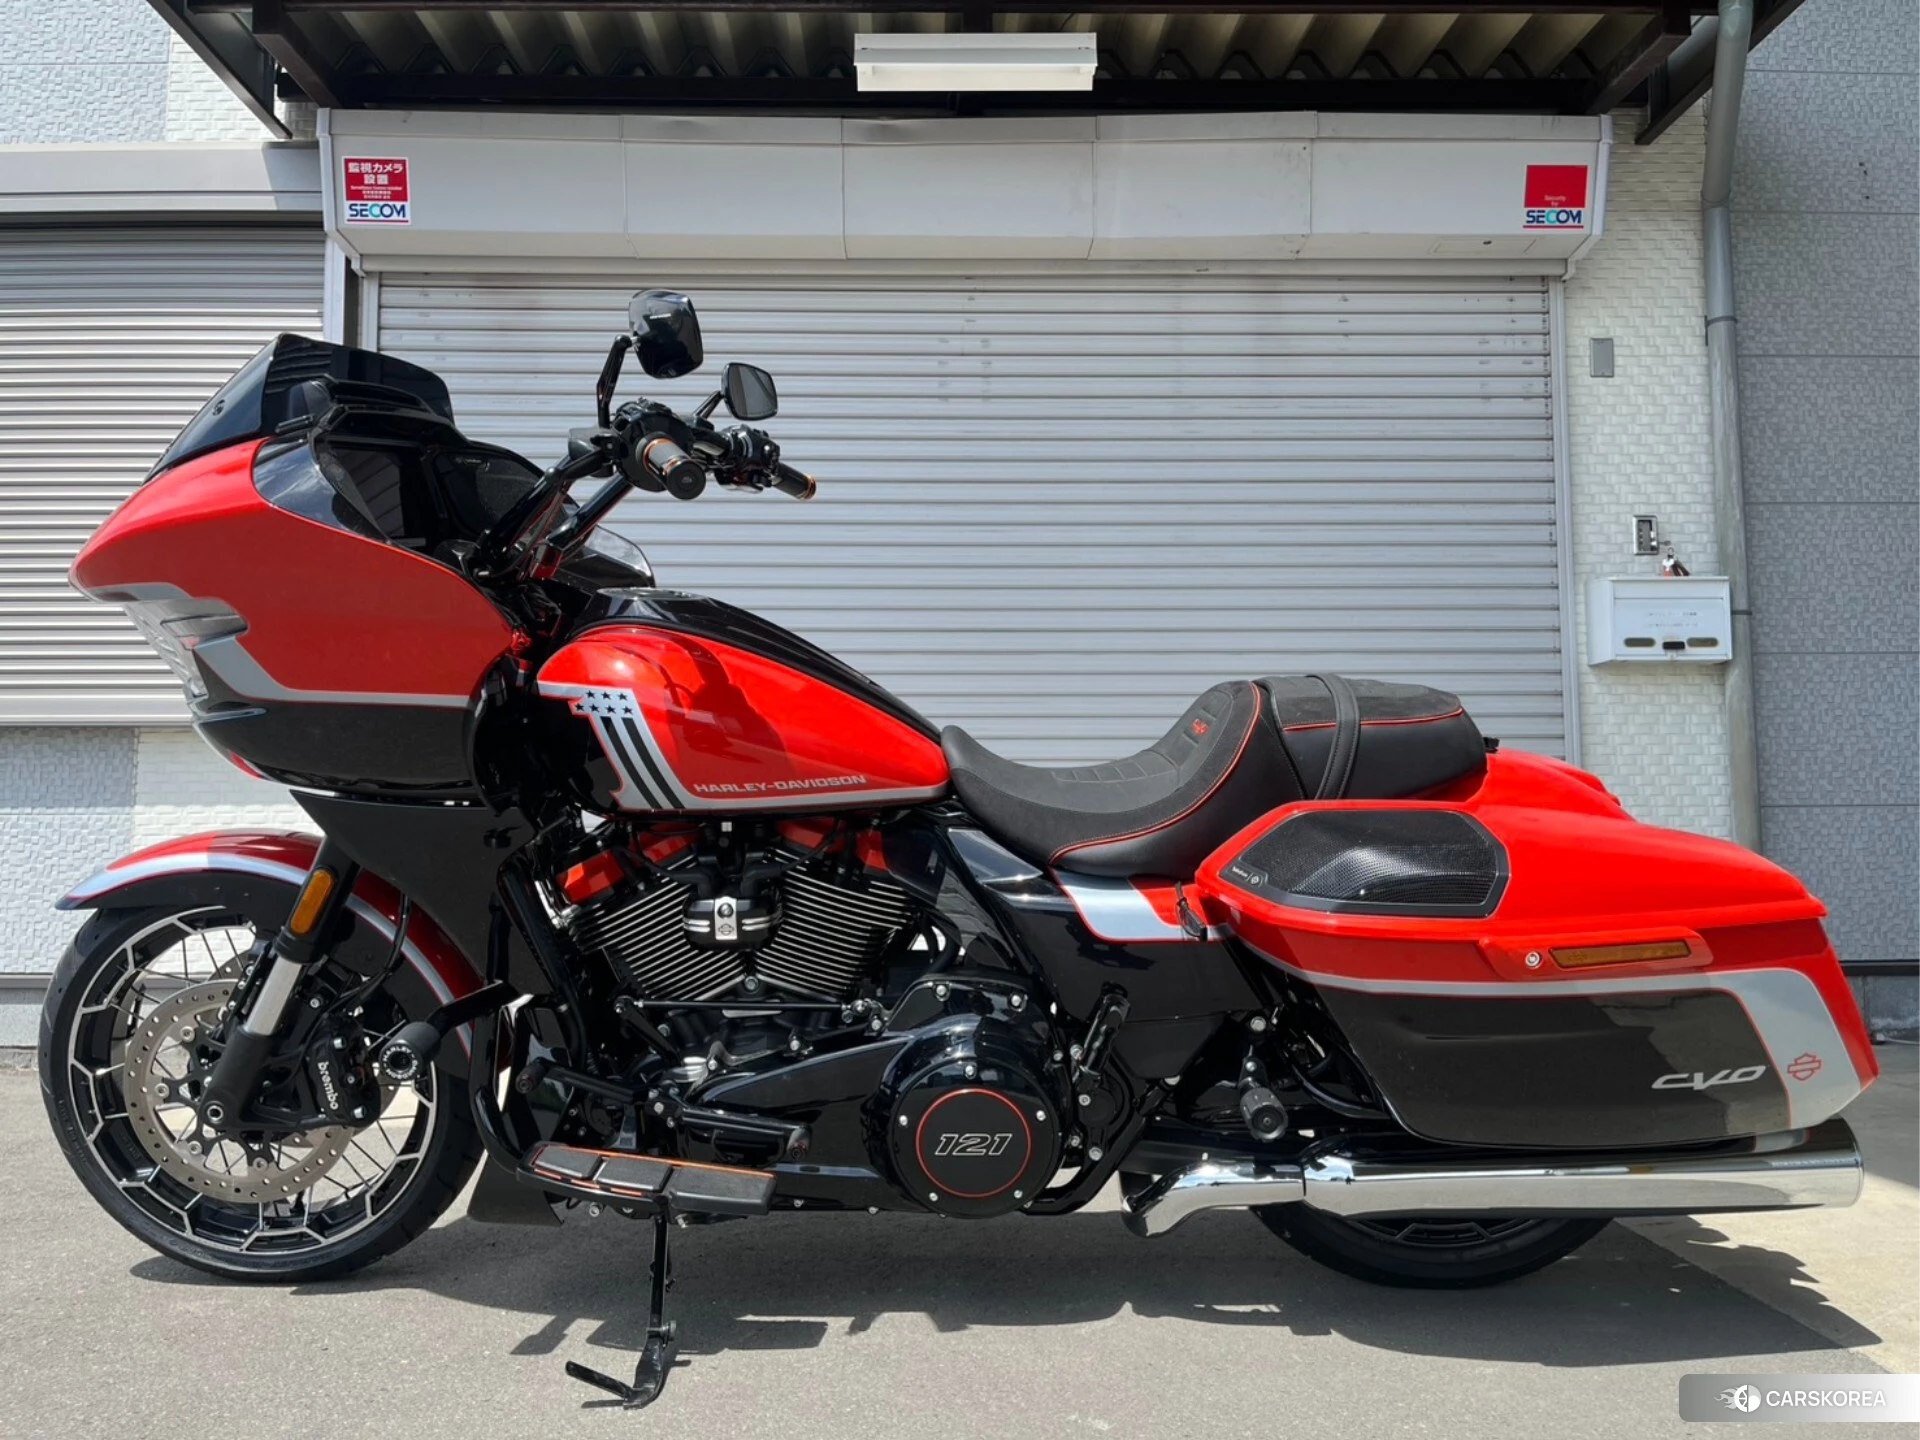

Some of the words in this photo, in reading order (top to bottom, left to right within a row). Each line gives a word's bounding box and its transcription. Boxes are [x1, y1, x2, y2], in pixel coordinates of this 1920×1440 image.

[349, 203, 405, 218] SECOM
[1526, 209, 1582, 224] SECOM
[694, 775, 867, 793] HARLEY-DAVIDSON
[317, 1061, 339, 1110] brembo
[1651, 1065, 1767, 1091] CVO
[934, 1133, 1013, 1156] 121
